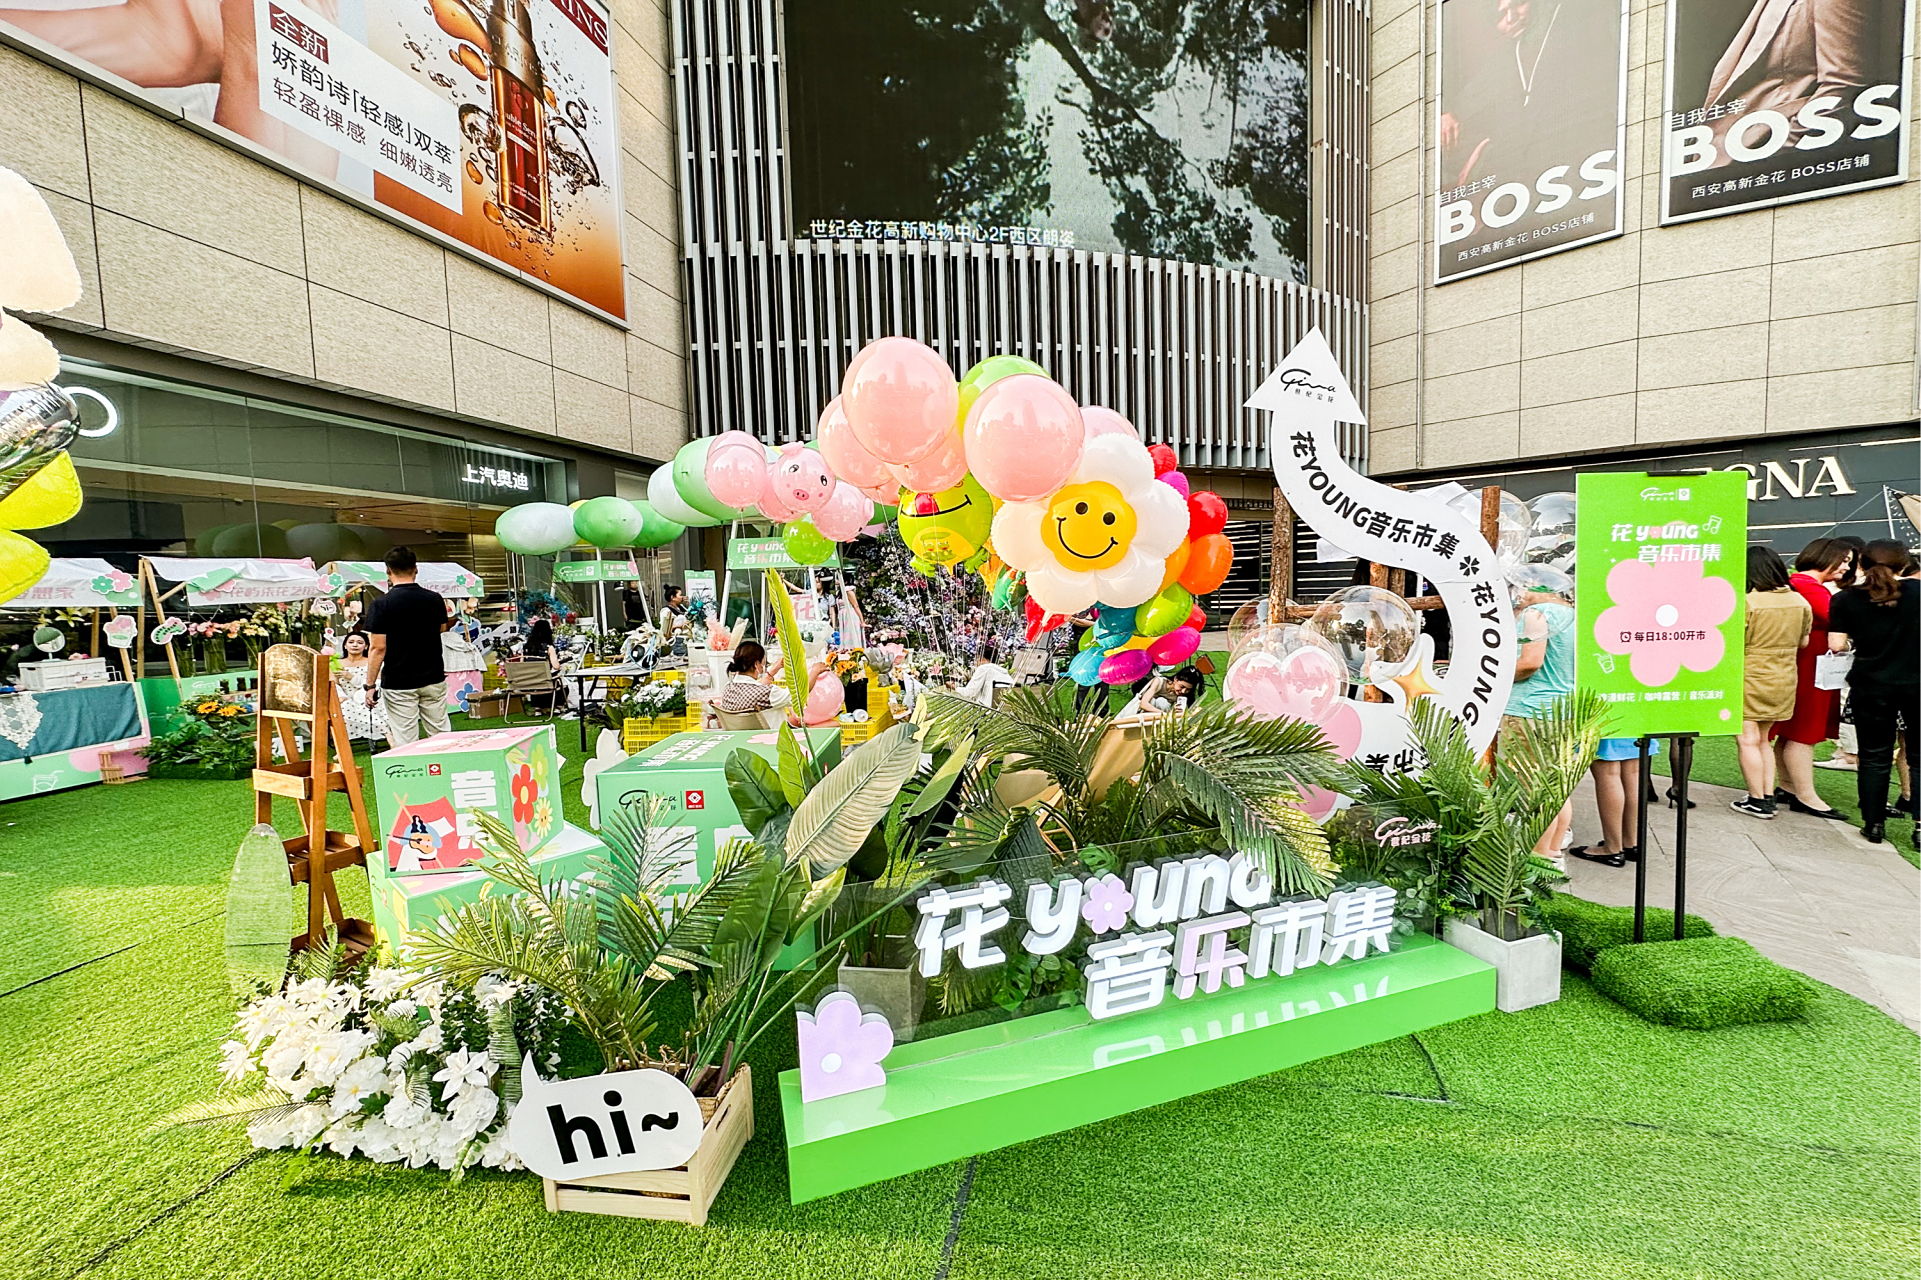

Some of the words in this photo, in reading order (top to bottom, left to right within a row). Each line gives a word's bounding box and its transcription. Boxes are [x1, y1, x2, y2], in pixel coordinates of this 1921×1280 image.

[272, 12, 326, 60] 全新
[560, 0, 608, 47] INS
[273, 77, 366, 145] 轻盈裸感
[379, 138, 453, 193] 细嫩透亮
[1670, 84, 1901, 178] BOSS
[1671, 99, 1747, 129] 自我主宰
[1440, 150, 1617, 245] BOSS
[1692, 170, 1785, 198] 西安高新金花
[1791, 154, 1870, 180] BOSS店铺
[1457, 232, 1529, 261] 西安高新金花
[1533, 212, 1595, 240] BOSS店铺
[461, 463, 529, 490] 上汽奥迪
[1290, 431, 1460, 559] 花YOUNG音乐市集
[1611, 523, 1633, 541] 花
[1638, 543, 1722, 563] 音乐市集
[1634, 630, 1706, 642] 每日18:00开市
[915, 877, 1011, 978] 花
[1085, 884, 1398, 1020] 音乐市集
[546, 1089, 680, 1165] hi~
